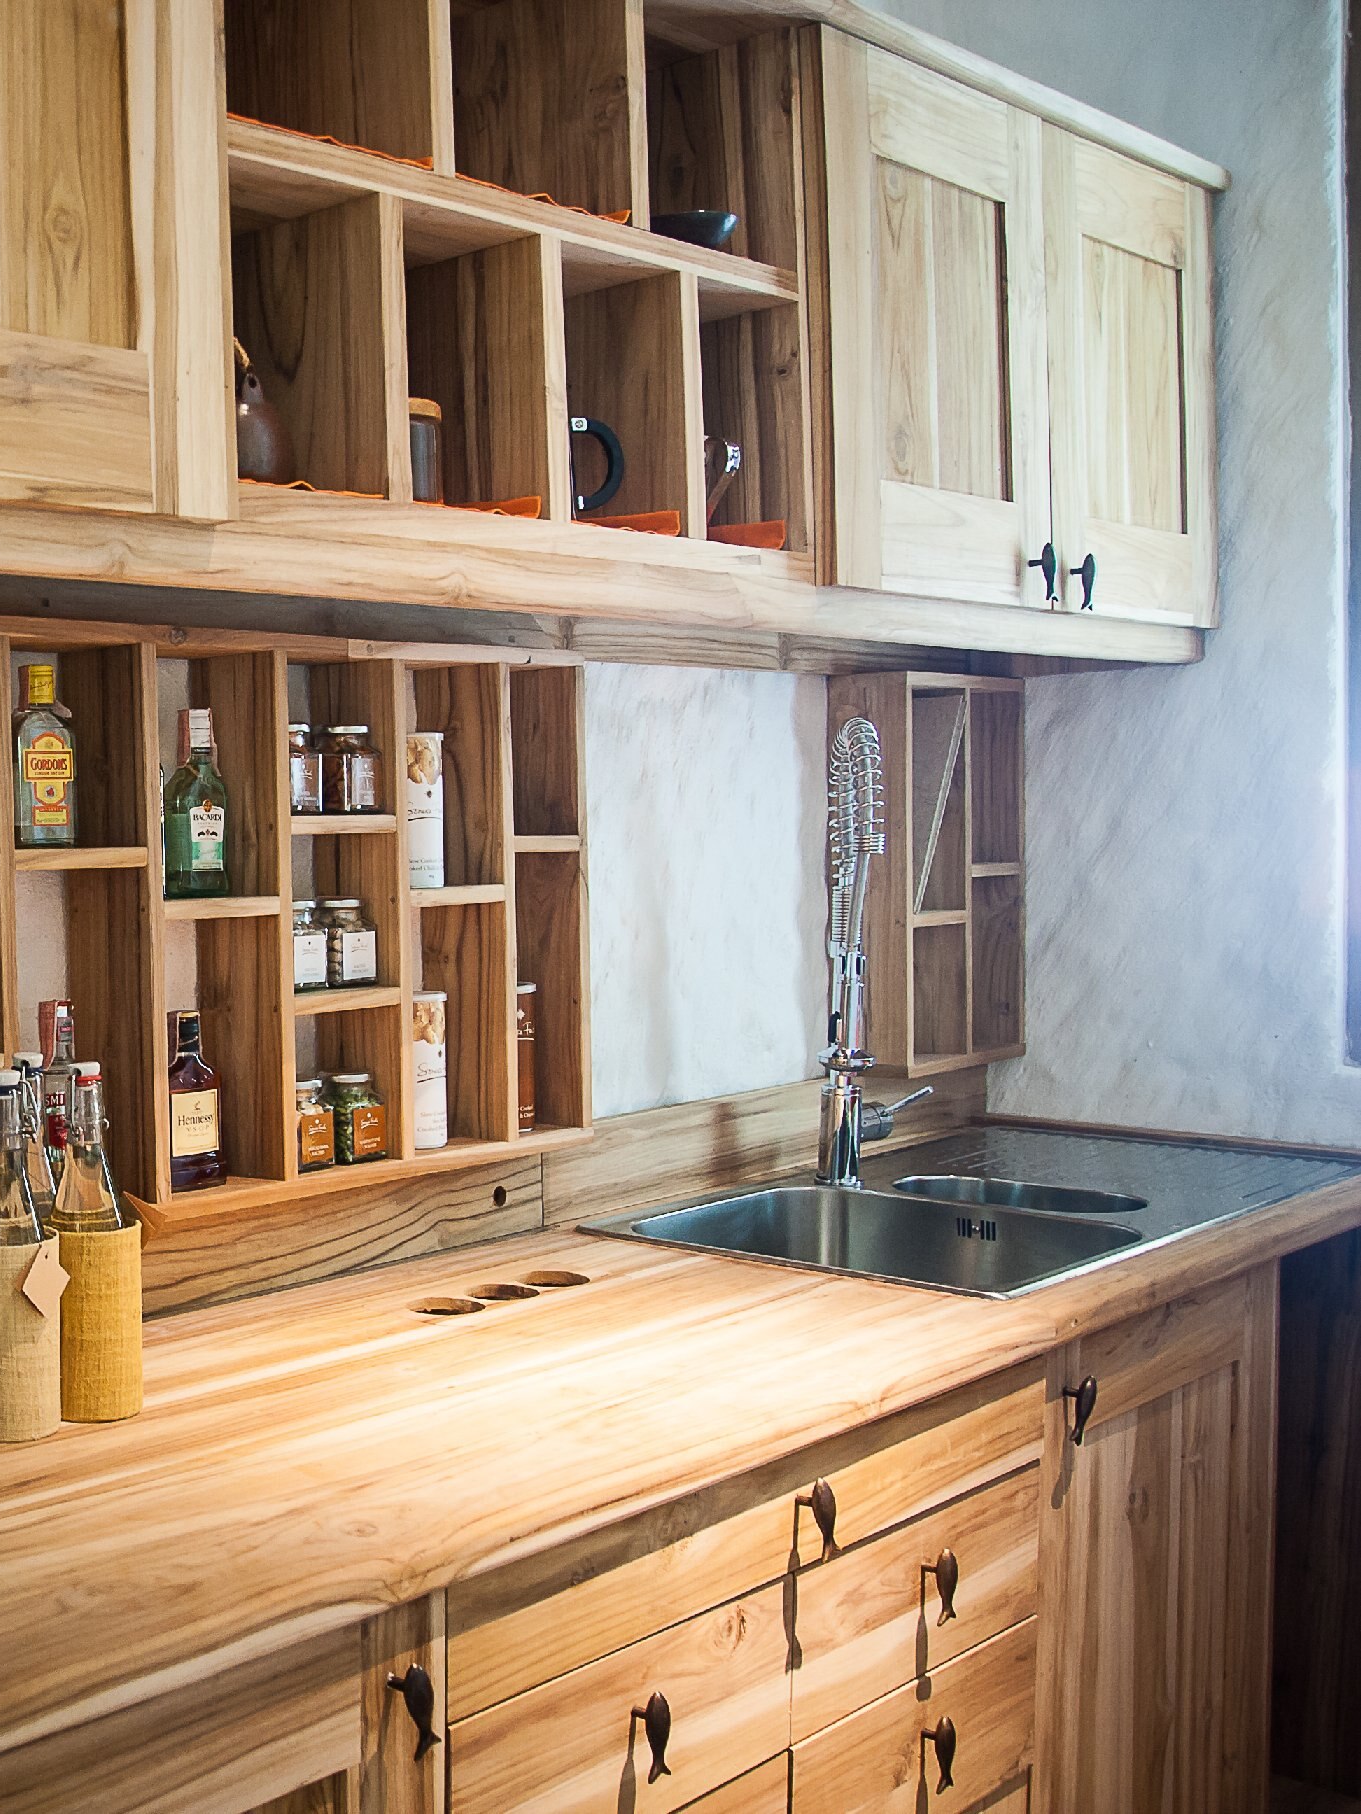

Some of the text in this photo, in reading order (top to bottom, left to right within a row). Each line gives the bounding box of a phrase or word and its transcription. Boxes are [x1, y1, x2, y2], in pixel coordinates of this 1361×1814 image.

[30, 757, 68, 771] GORDON'S
[192, 812, 222, 822] BACARDI
[177, 1113, 213, 1127] Hennessy
